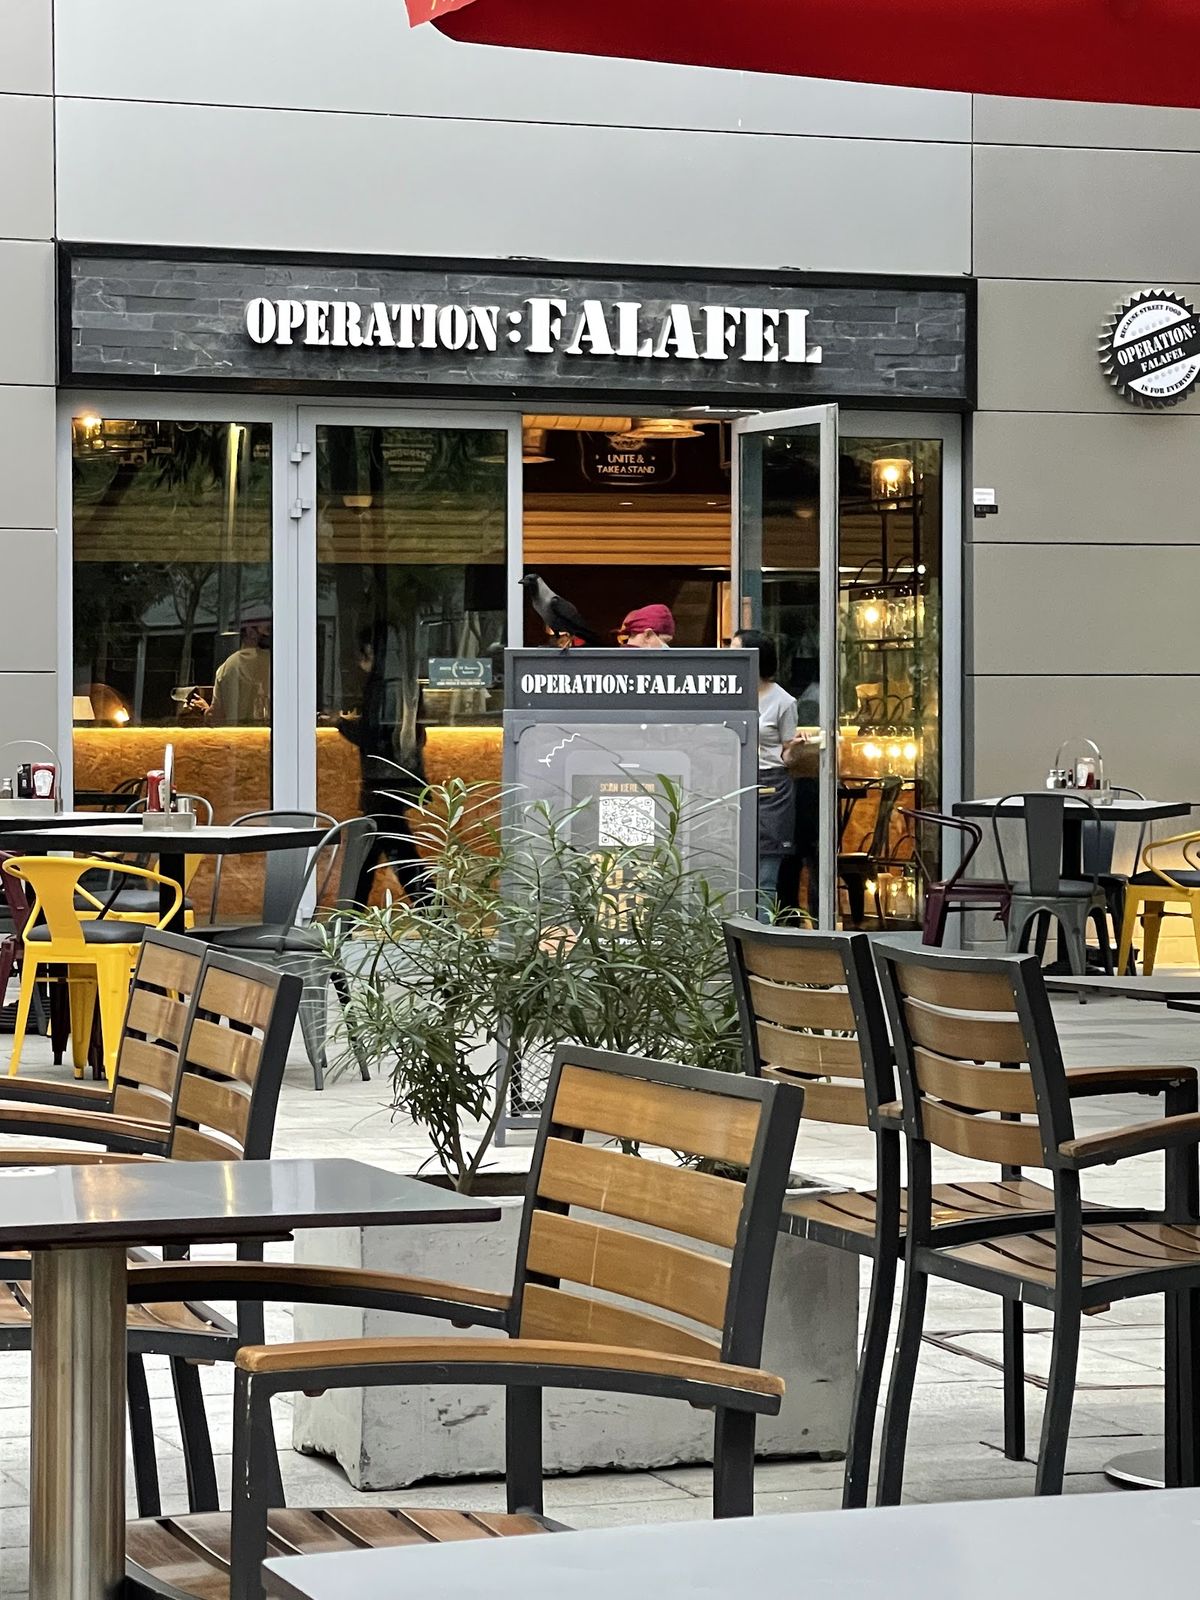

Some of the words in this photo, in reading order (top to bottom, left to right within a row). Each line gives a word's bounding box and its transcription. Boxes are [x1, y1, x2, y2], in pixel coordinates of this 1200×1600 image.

[1119, 311, 1139, 339] BECAUSE
[1139, 304, 1164, 315] STREET
[1165, 305, 1182, 317] FOOD
[1117, 322, 1197, 366] OPERATION:
[1140, 347, 1186, 373] FALAFEL
[1141, 384, 1148, 392] IS
[1166, 364, 1197, 393] EVERYONE
[596, 465, 620, 473] TAKE
[620, 465, 627, 473] A
[628, 465, 656, 474] STAND
[607, 454, 636, 463] UNITE
[636, 454, 645, 463] &
